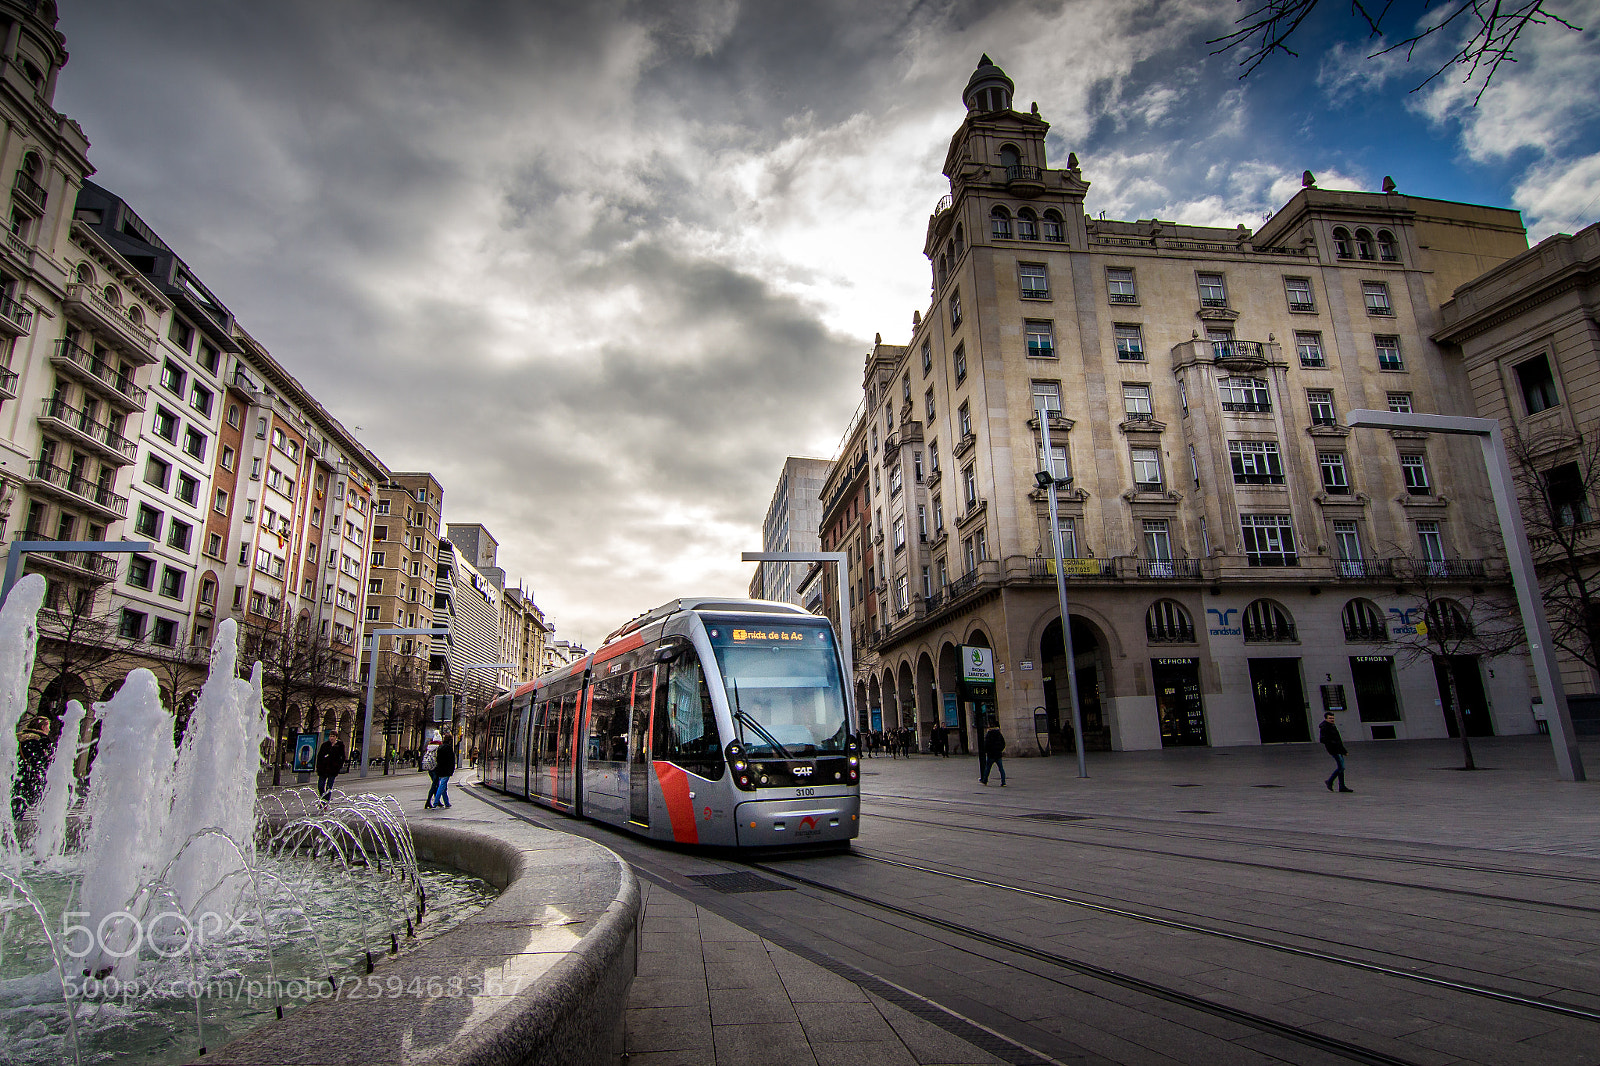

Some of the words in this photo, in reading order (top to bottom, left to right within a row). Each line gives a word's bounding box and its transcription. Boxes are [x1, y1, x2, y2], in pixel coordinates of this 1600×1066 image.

[1210, 627, 1241, 636] randstad
[1393, 626, 1418, 634] randsta
[768, 631, 780, 640] de
[1325, 673, 1332, 682] 3
[1488, 669, 1495, 678] 3
[792, 766, 813, 777] CAF
[795, 788, 815, 797] 3100
